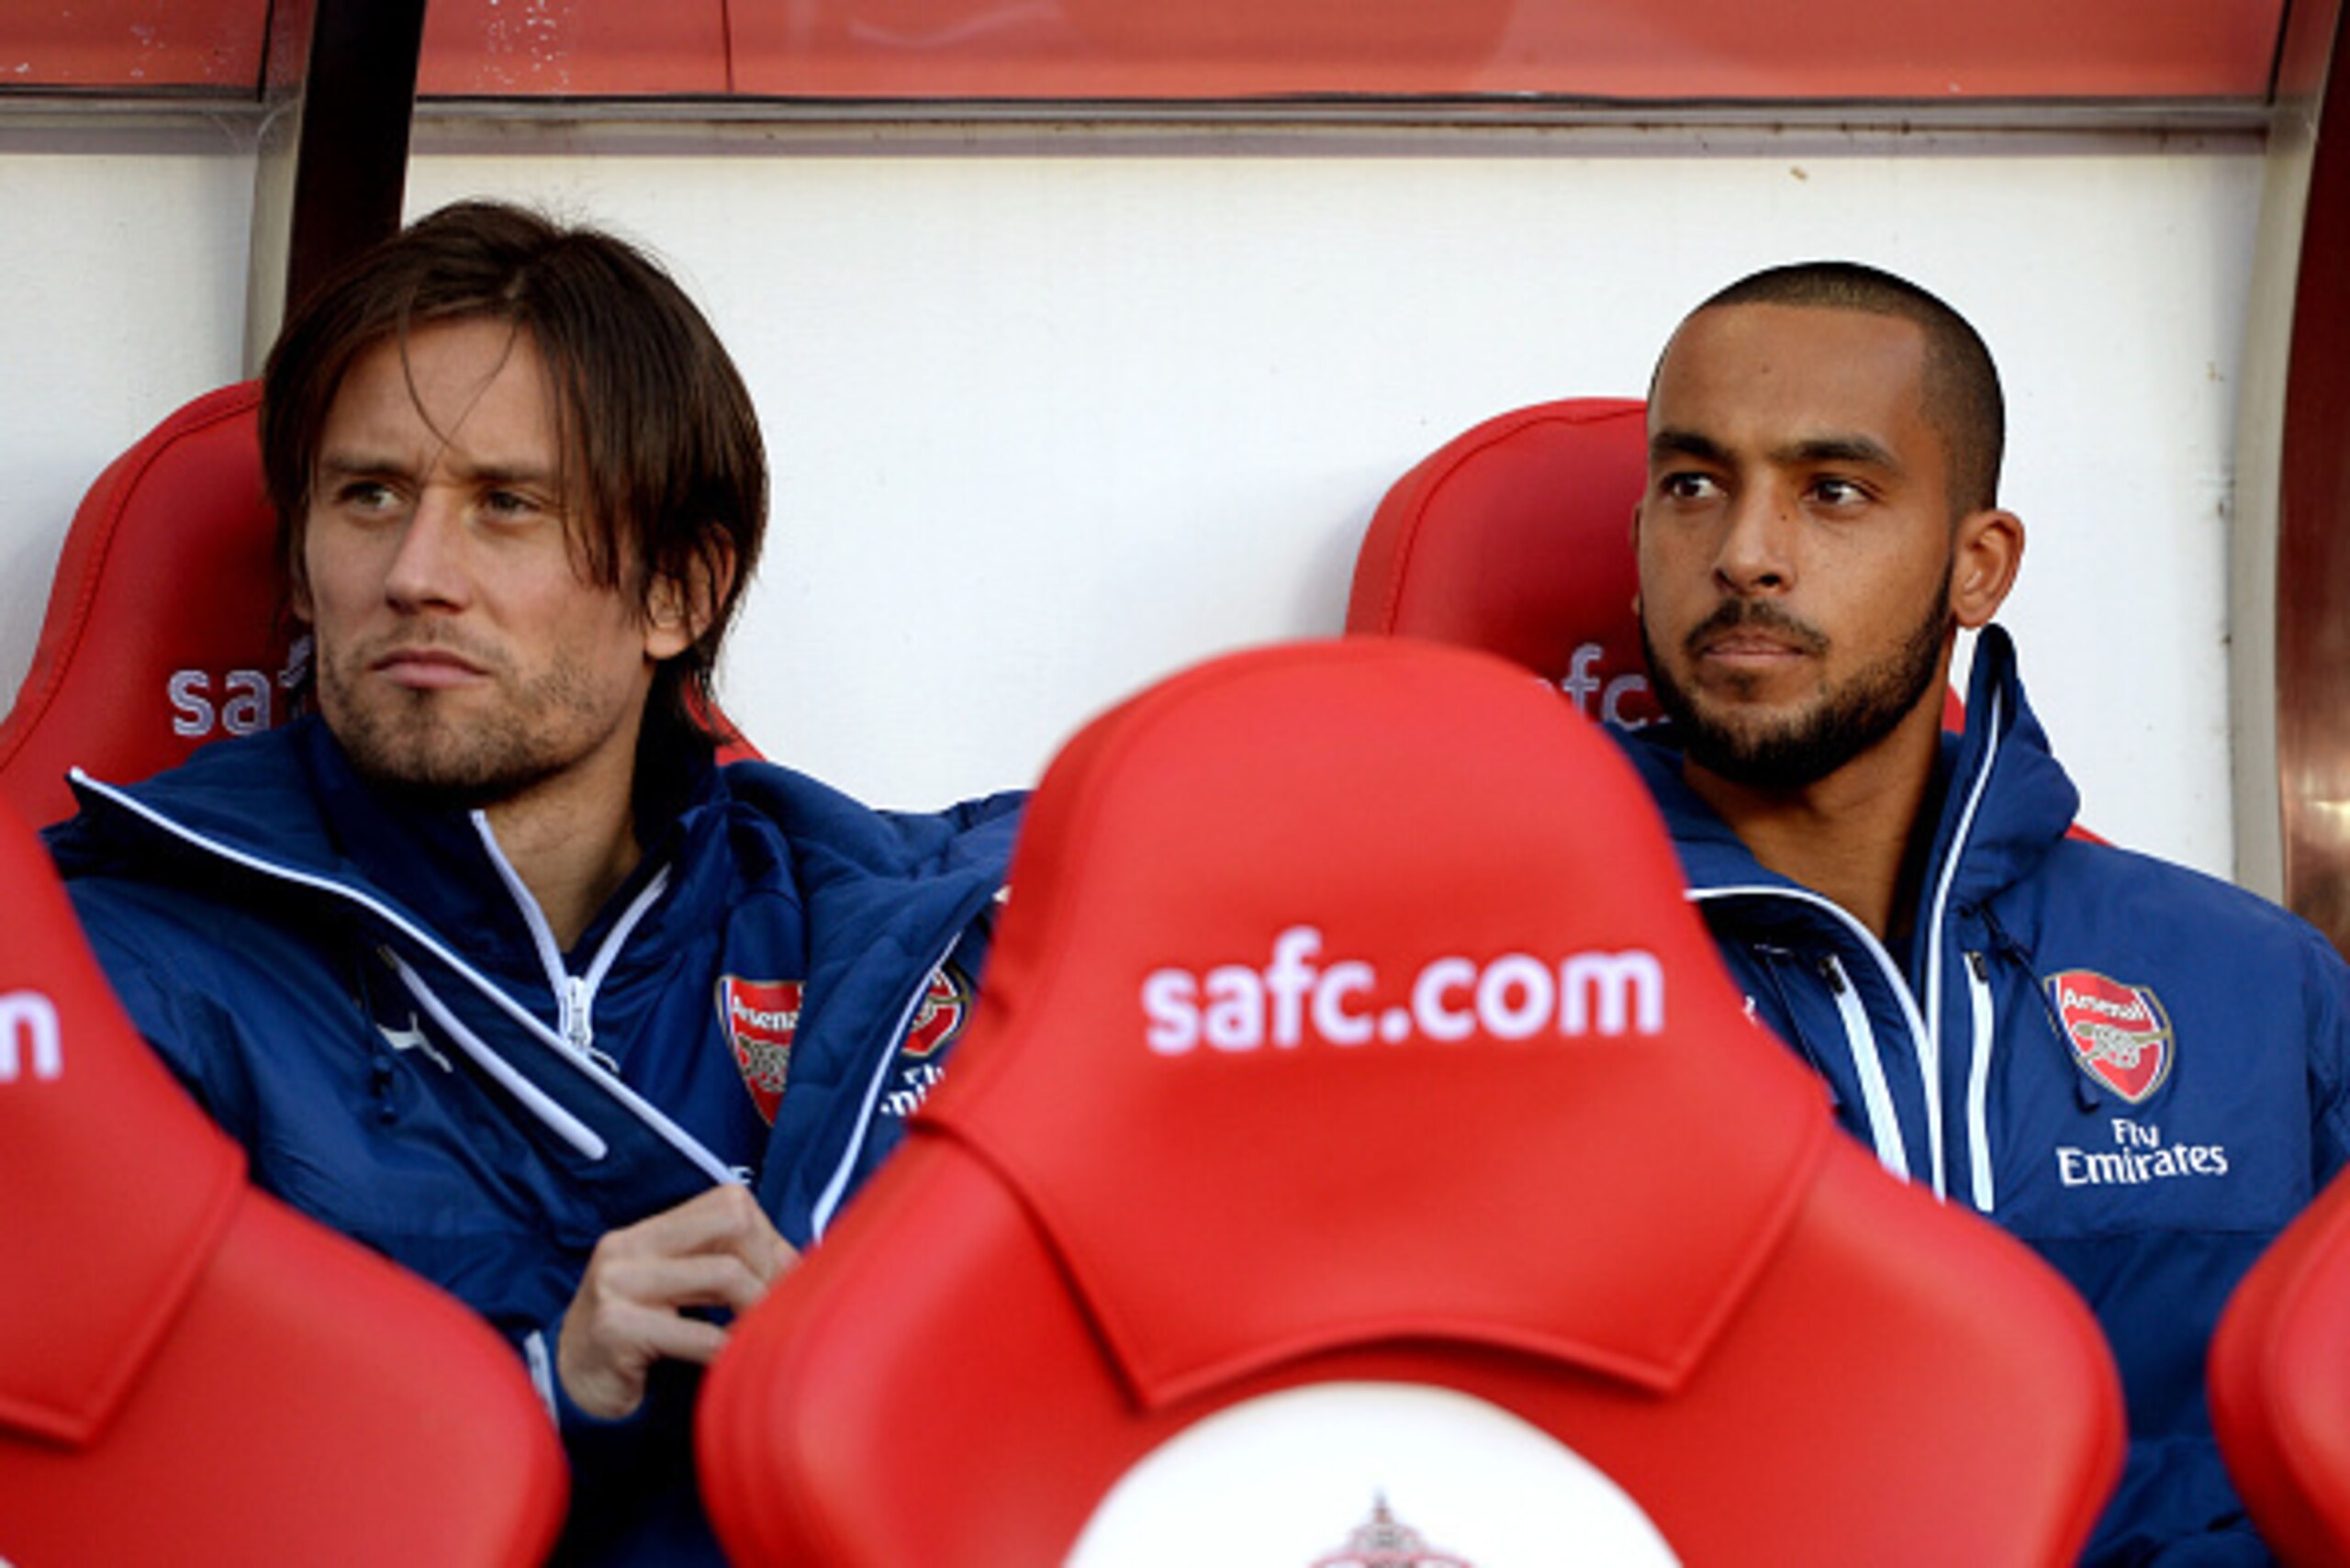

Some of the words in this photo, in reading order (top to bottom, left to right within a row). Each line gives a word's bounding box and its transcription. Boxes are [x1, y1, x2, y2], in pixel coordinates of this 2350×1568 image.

[1141, 925, 1664, 1055] safc.com
[2062, 988, 2145, 1021] Arsenal
[2111, 1117, 2160, 1148] Fly
[2056, 1144, 2229, 1186] Emirates
